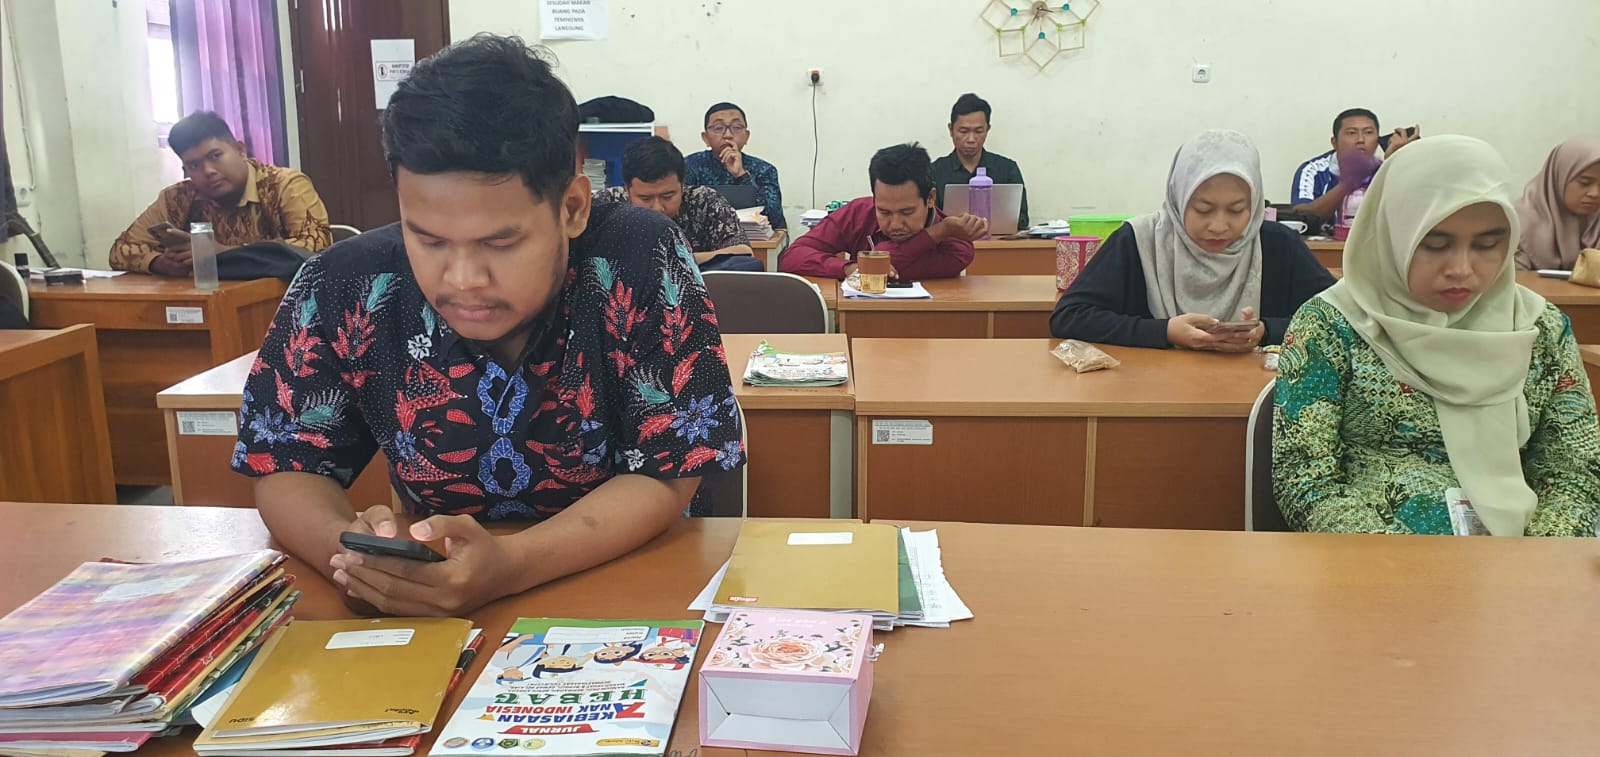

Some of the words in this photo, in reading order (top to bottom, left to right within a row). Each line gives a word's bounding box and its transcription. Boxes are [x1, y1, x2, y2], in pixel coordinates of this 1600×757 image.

[493, 688, 648, 705] HEBAT
[485, 705, 574, 714] INDONESIA
[614, 702, 646, 719] 7
[228, 716, 256, 725] SIDU
[497, 712, 614, 723] KEBIASAAN
[519, 726, 581, 735] JURNAL
